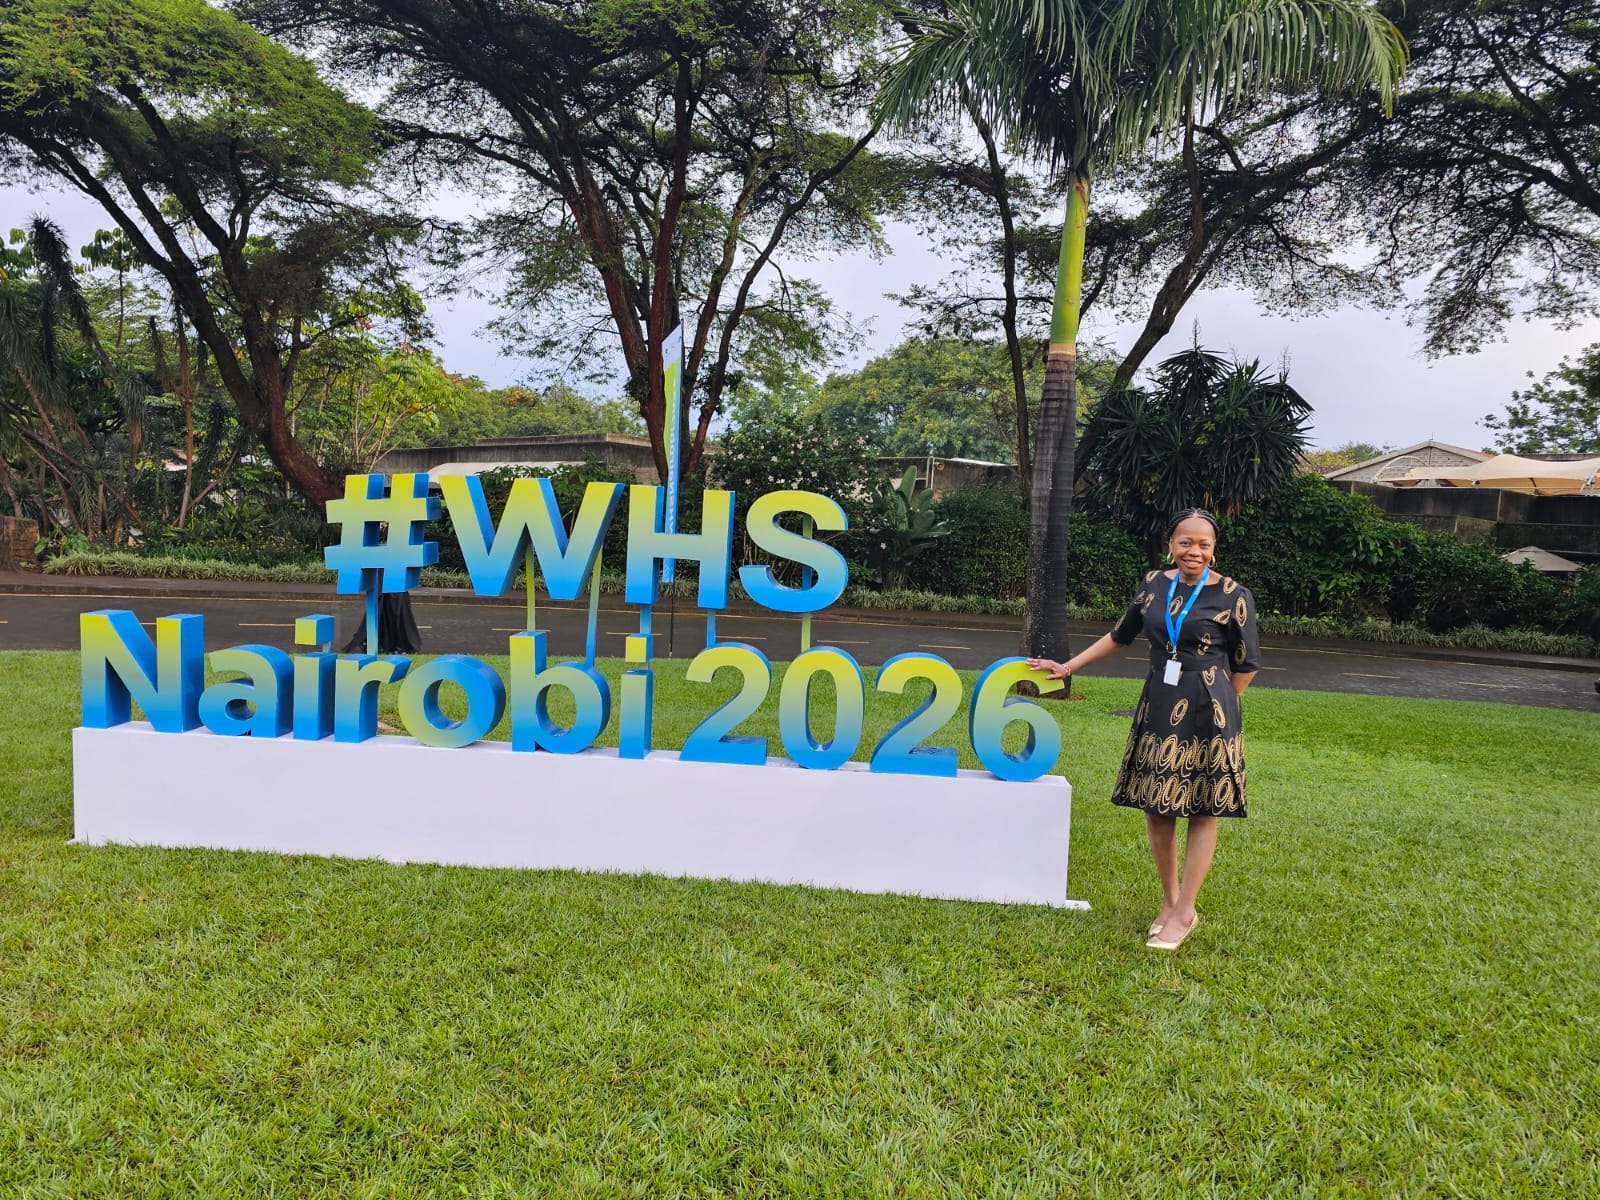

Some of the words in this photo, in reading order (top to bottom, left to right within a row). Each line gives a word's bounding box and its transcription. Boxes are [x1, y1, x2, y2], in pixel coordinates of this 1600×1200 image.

[324, 473, 849, 612] #WHS
[80, 609, 653, 759] Nairobi
[679, 642, 1065, 782] 2026
